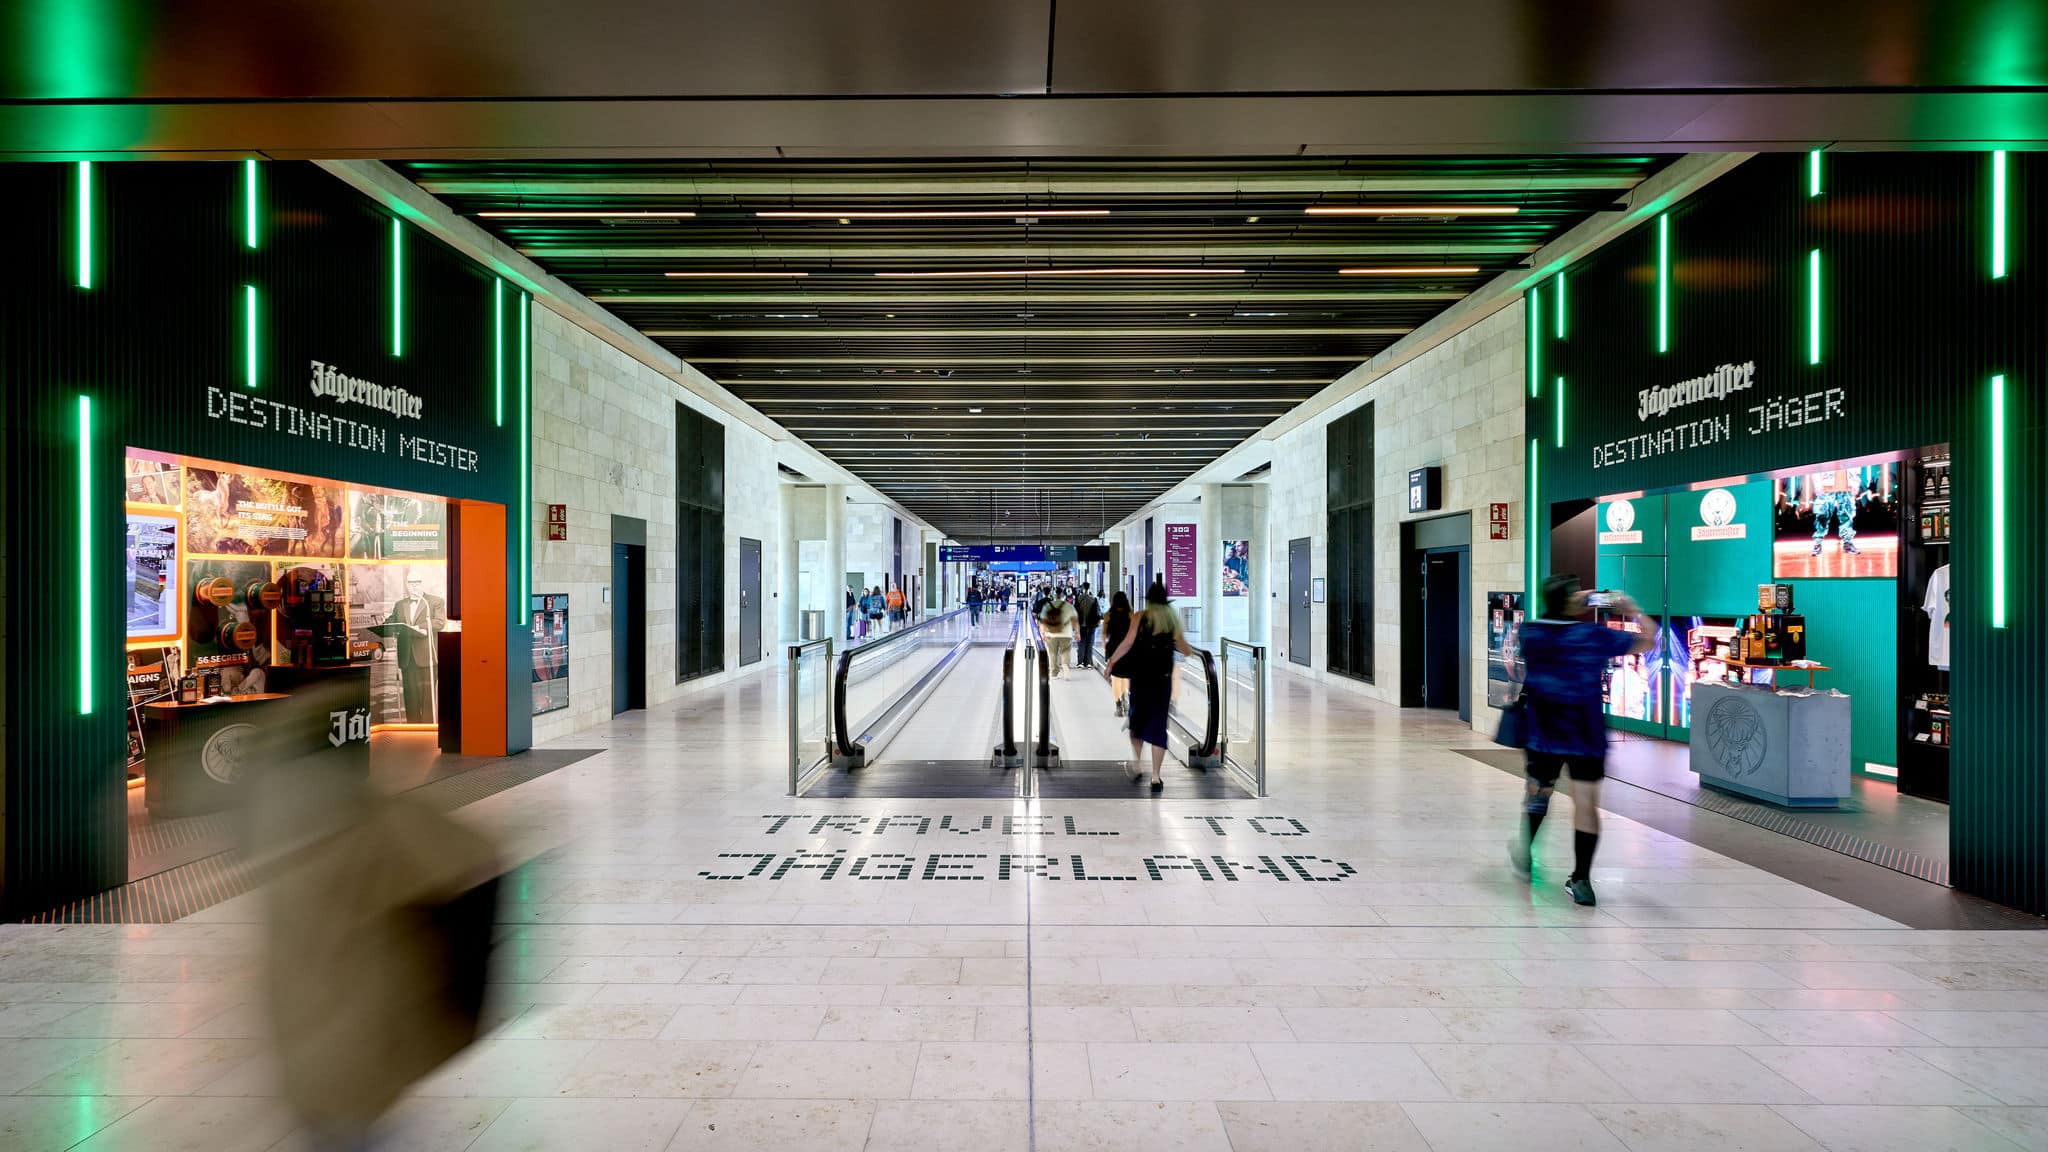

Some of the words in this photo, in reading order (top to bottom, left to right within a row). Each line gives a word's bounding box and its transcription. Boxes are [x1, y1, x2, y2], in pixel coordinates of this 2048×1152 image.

[310, 360, 423, 420] Jägermeister
[1638, 361, 1756, 422] Jägermeister
[207, 386, 386, 453] DESTINATION
[399, 433, 479, 473] MEISTER
[1593, 413, 1731, 469] DESTINATION
[1748, 387, 1846, 435] JÄGER
[237, 500, 254, 509] THE
[286, 505, 302, 513] GOT
[197, 656, 209, 665] 56
[210, 652, 248, 663] SECRETS
[762, 815, 1120, 836] TRAVEL
[1184, 816, 1310, 836] TO
[697, 849, 1358, 882] JÄGERLAND
